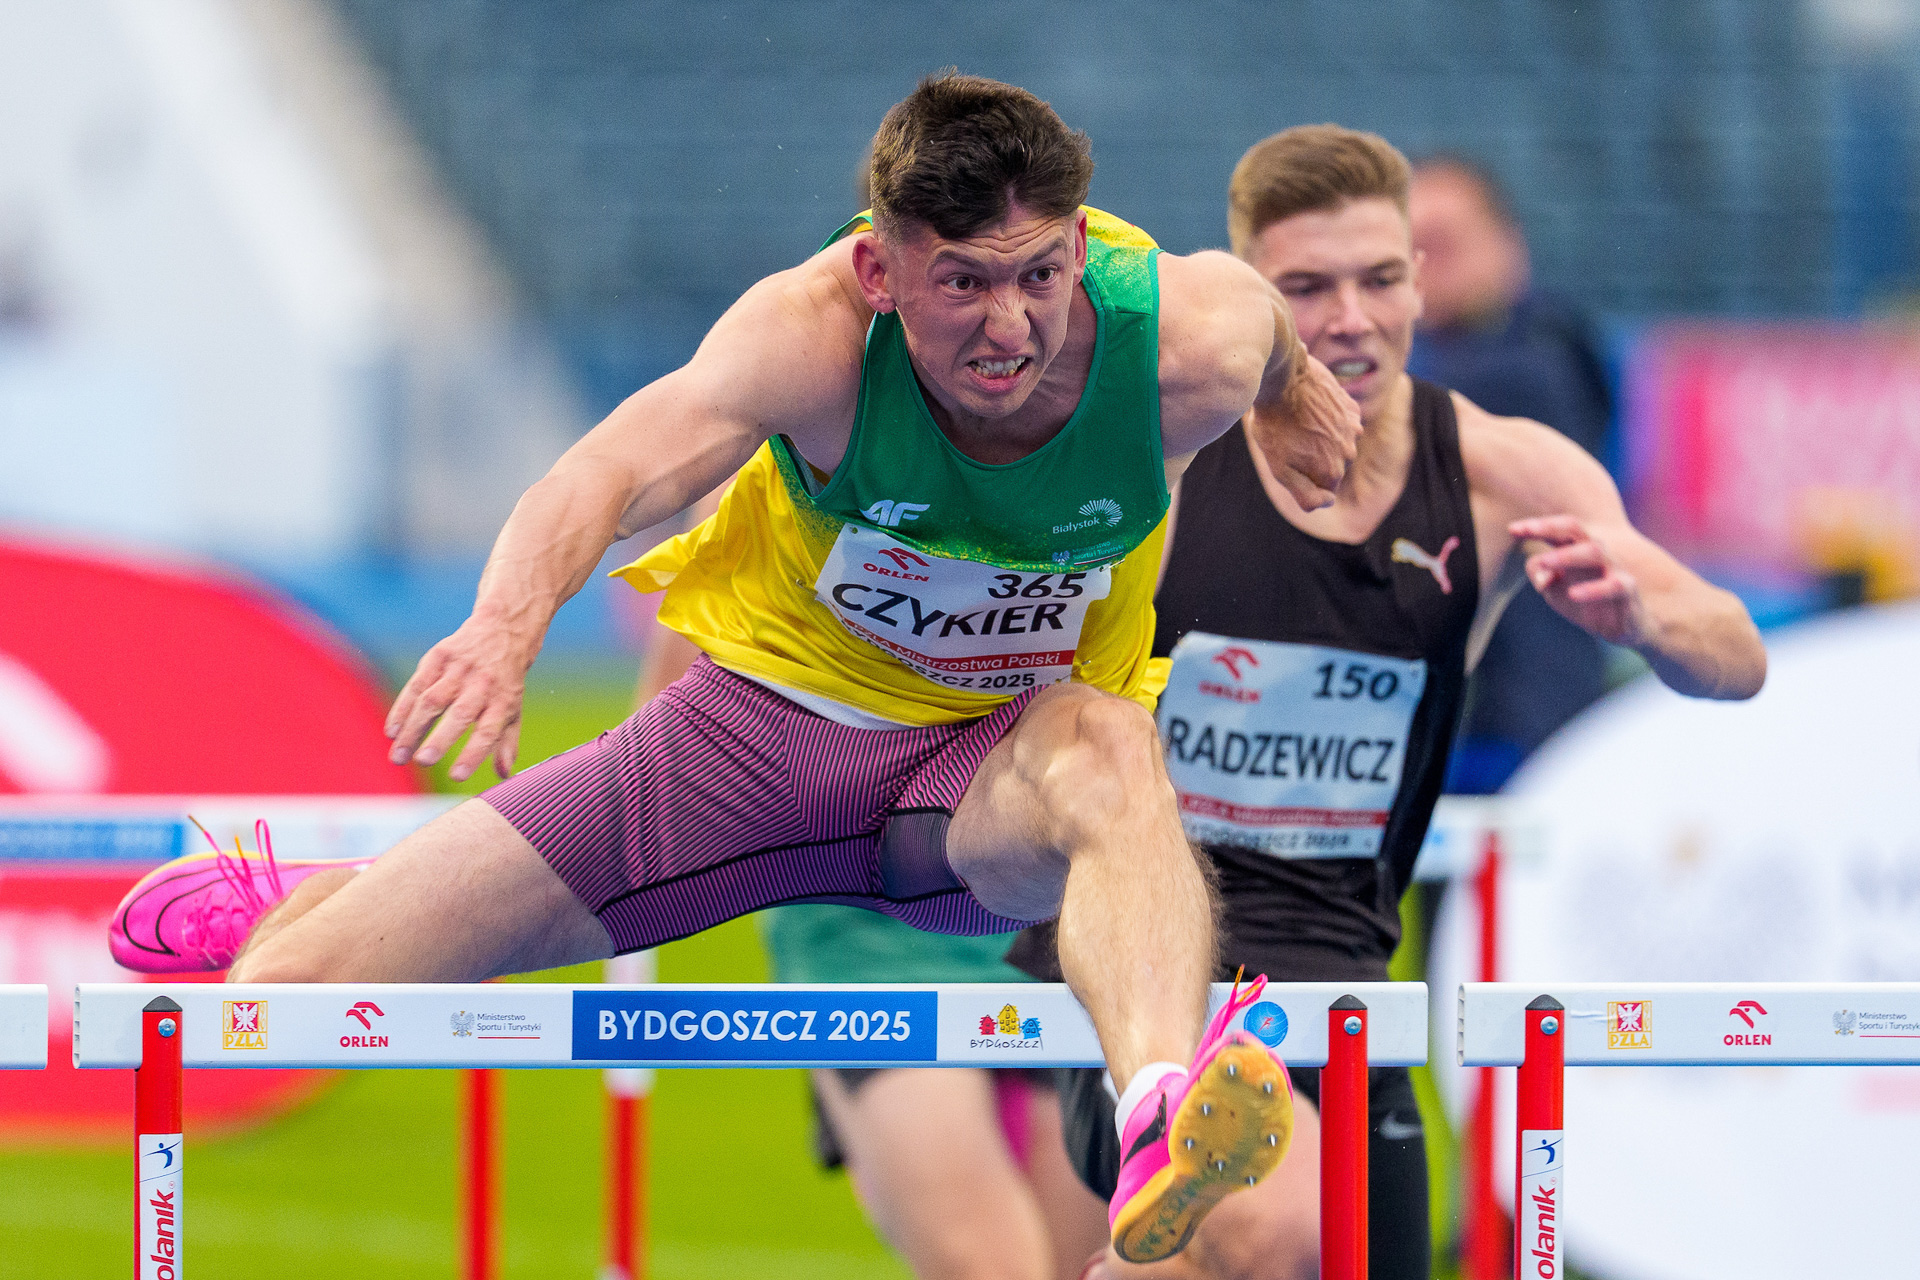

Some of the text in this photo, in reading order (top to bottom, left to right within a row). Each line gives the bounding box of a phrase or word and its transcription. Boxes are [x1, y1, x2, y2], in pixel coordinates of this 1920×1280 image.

[863, 562, 930, 582] ORLEN
[987, 573, 1087, 599] 365
[831, 583, 1068, 638] CZYKIER
[896, 646, 1003, 671] Mistrzostwa
[1007, 651, 1060, 668] Polski
[978, 673, 1036, 689] 2025
[1313, 660, 1399, 702] 150
[1167, 716, 1396, 783] RADZEWICZ
[477, 1013, 526, 1021] Ministerstwo
[1859, 1012, 1907, 1020] Ministerstwo
[477, 1022, 502, 1032] Sportu
[508, 1022, 542, 1032] Turystyki
[598, 1009, 911, 1042] BYDGOSZCZ 2025
[1859, 1022, 1884, 1030] Sportu
[1890, 1022, 1920, 1031] Turystyk
[224, 1033, 265, 1048] PZLA
[339, 1035, 389, 1048] ORLEN
[970, 1038, 1039, 1049] BYDGOSZCZ
[1610, 1033, 1650, 1047] PZLA
[1723, 1034, 1772, 1046] ORLEN
[149, 1188, 175, 1280] olanik
[1531, 1184, 1556, 1280] olanik
